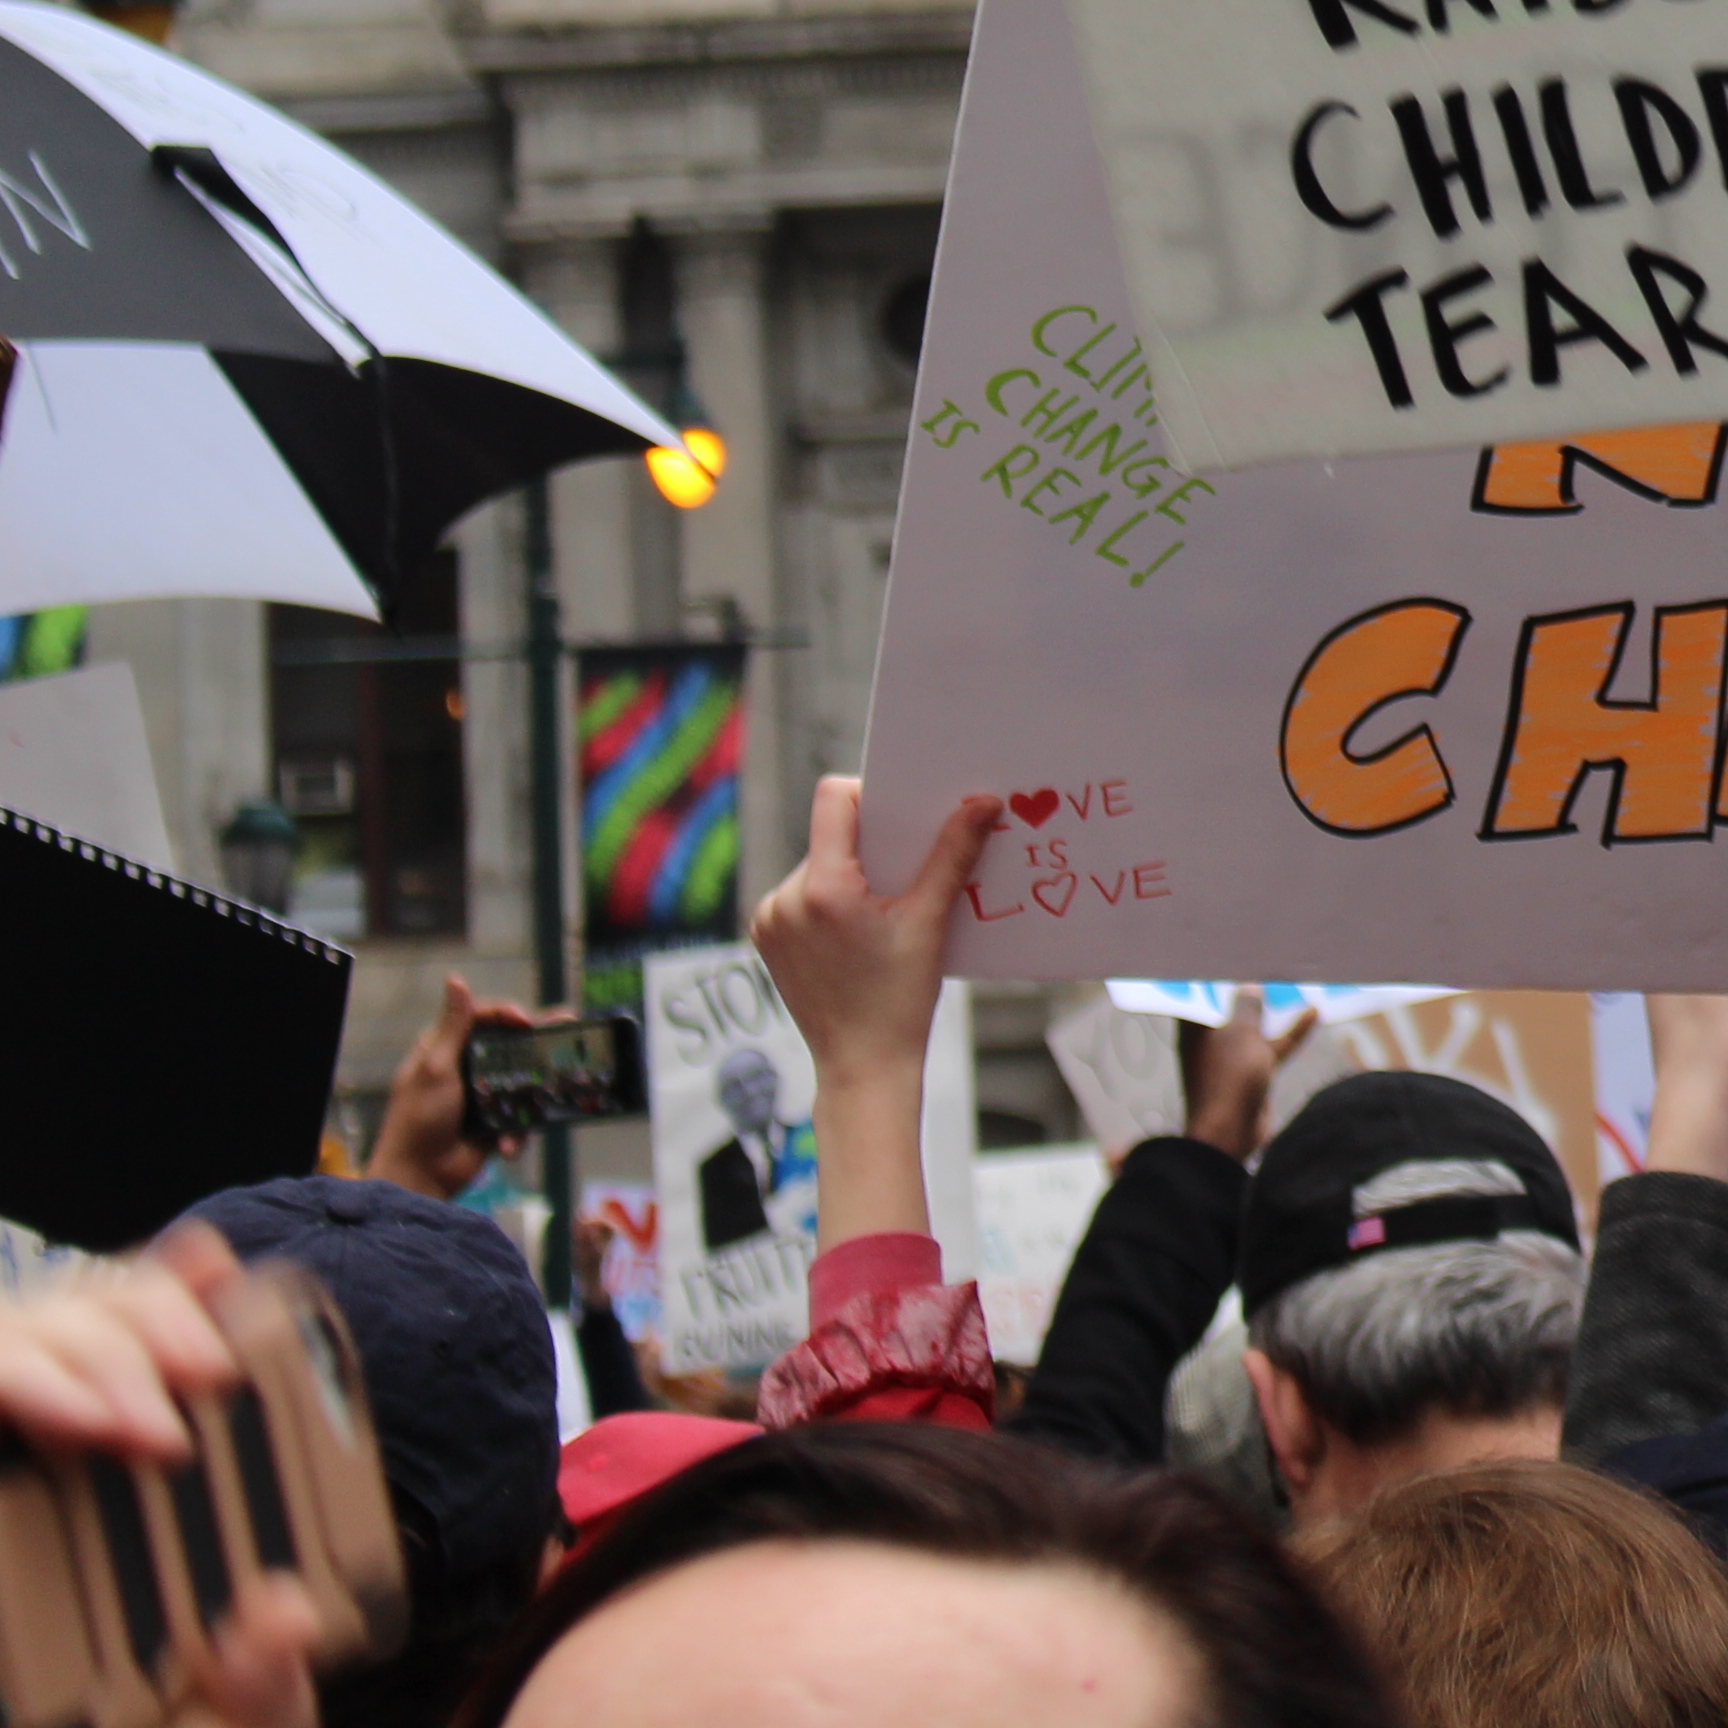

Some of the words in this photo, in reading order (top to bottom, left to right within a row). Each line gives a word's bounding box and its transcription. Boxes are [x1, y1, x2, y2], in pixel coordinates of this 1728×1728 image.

[920, 398, 981, 449] IS
[980, 445, 1185, 589] REAL!
[984, 368, 1217, 526] CHANGE
[1025, 838, 1070, 870] IS
